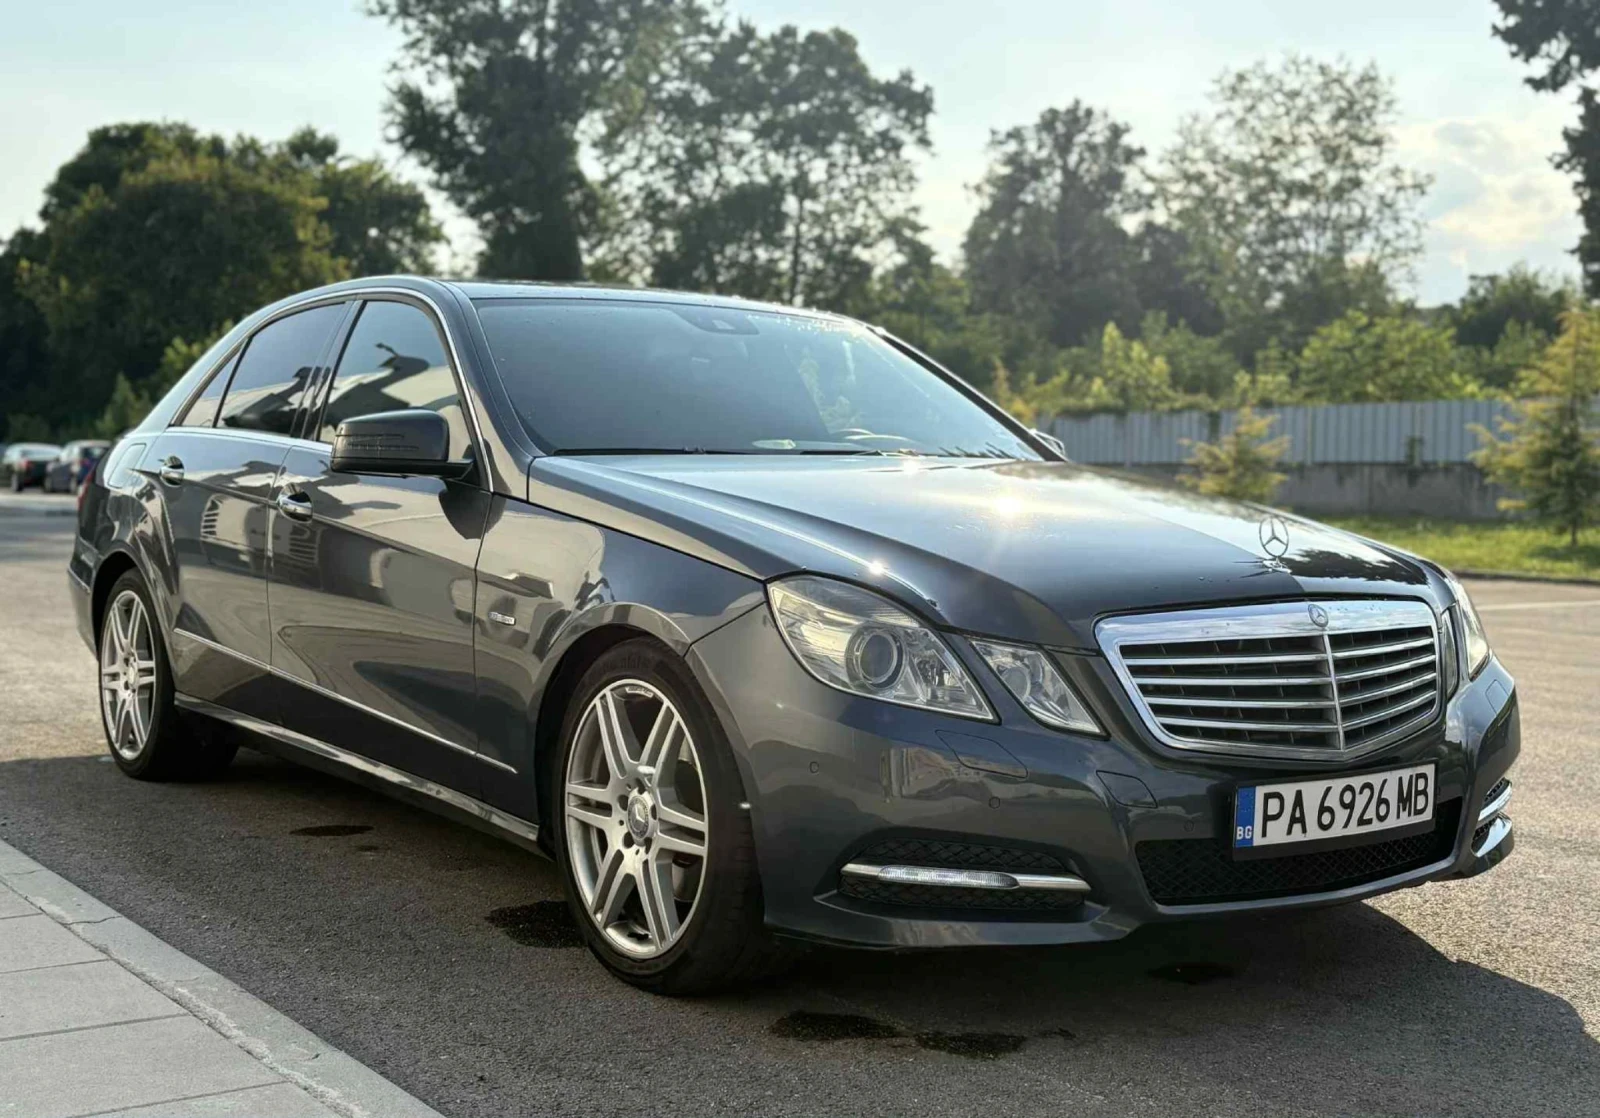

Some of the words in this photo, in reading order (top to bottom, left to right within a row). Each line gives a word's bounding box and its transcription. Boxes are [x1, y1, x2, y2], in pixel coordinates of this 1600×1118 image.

[1261, 789, 1308, 838] PA
[1317, 778, 1391, 831] 6926
[1396, 772, 1429, 820] MB
[1236, 826, 1252, 840] BG
